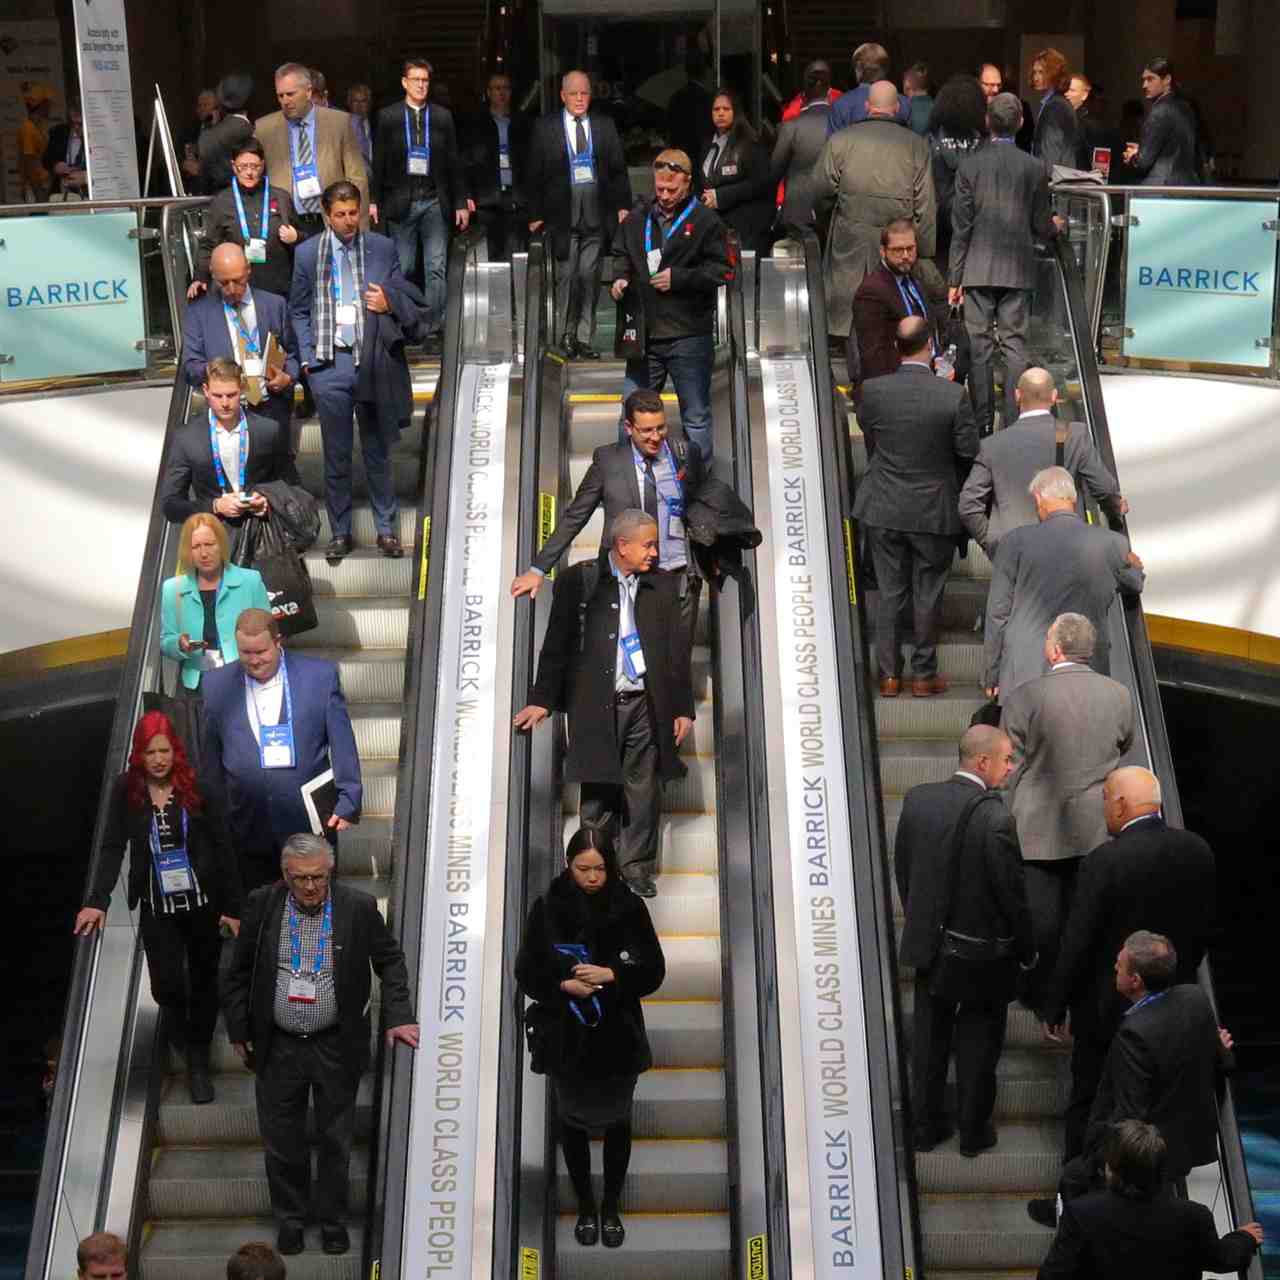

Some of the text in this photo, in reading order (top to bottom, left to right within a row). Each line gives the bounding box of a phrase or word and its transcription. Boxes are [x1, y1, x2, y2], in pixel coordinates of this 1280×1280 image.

[7, 279, 129, 307] BARRICK
[1138, 266, 1260, 291] BARRICK
[777, 383, 799, 416] CLASS
[469, 420, 492, 467] WORLD
[780, 420, 804, 470] WORLD
[783, 476, 807, 566] BARRICK
[790, 574, 815, 638] PEOPLE
[461, 594, 484, 691] BARRICK
[794, 643, 821, 699] CLASS
[798, 703, 825, 769] WORLD
[445, 835, 473, 894] MINES
[803, 776, 829, 887] BARRICK
[811, 896, 840, 957] MINES
[444, 903, 470, 1022] BARRICK
[815, 963, 843, 1032] CLASS
[435, 1033, 464, 1112] WORLD
[820, 1038, 849, 1119] WORLD
[431, 1119, 461, 1193] CLASS
[825, 1129, 855, 1268] BARRICK
